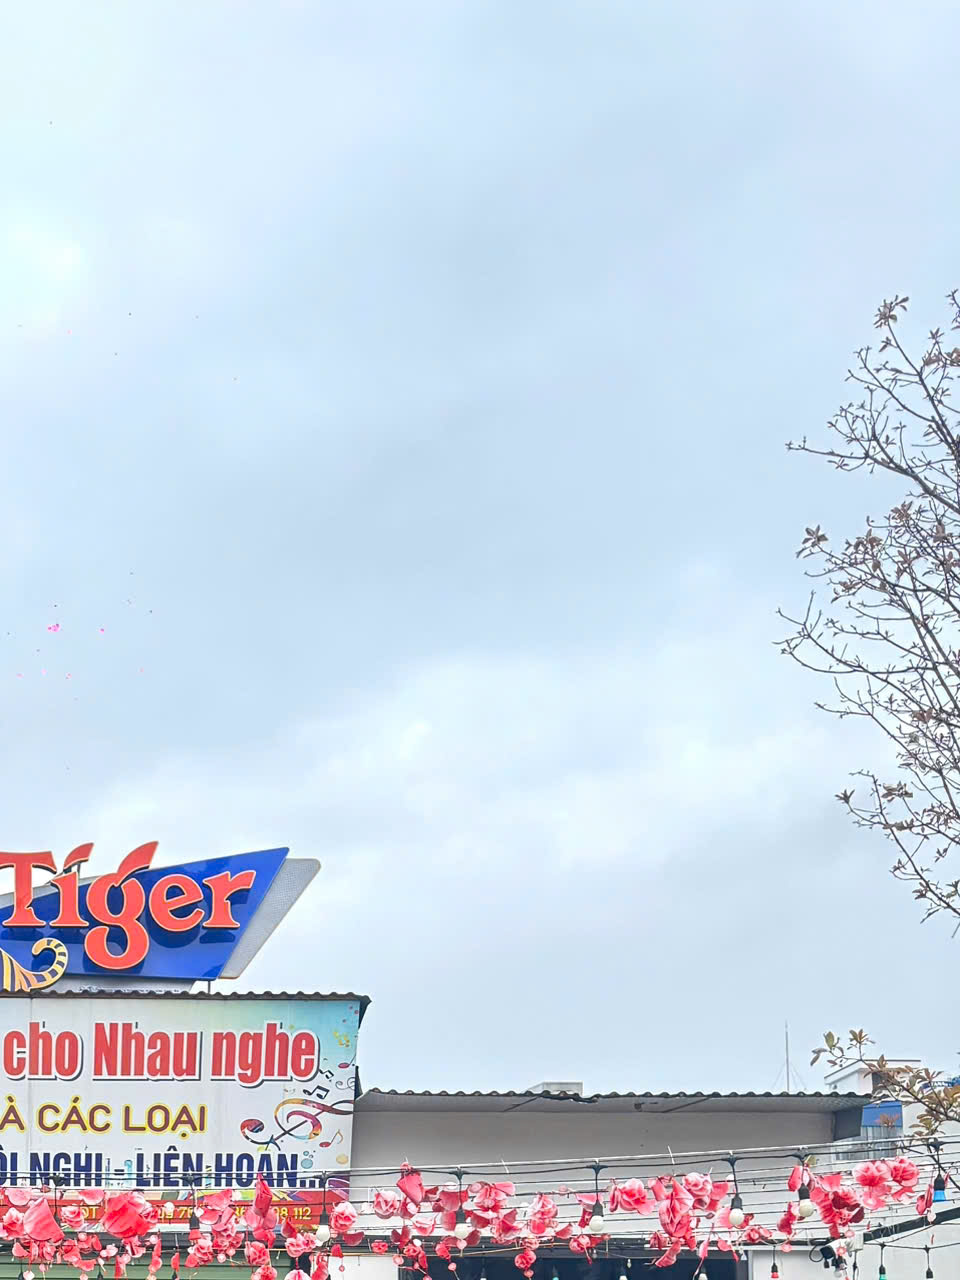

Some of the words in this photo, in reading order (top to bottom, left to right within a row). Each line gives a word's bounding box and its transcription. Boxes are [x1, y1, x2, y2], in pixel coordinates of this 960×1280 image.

[3, 1021, 80, 1077] cho
[93, 1022, 198, 1078] Nhau
[211, 1023, 317, 1084] nghe
[39, 1096, 111, 1133] CÁC
[123, 1105, 207, 1138] LOẠI
[135, 1145, 203, 1188] LIÊN
[293, 1207, 312, 1220] 112
